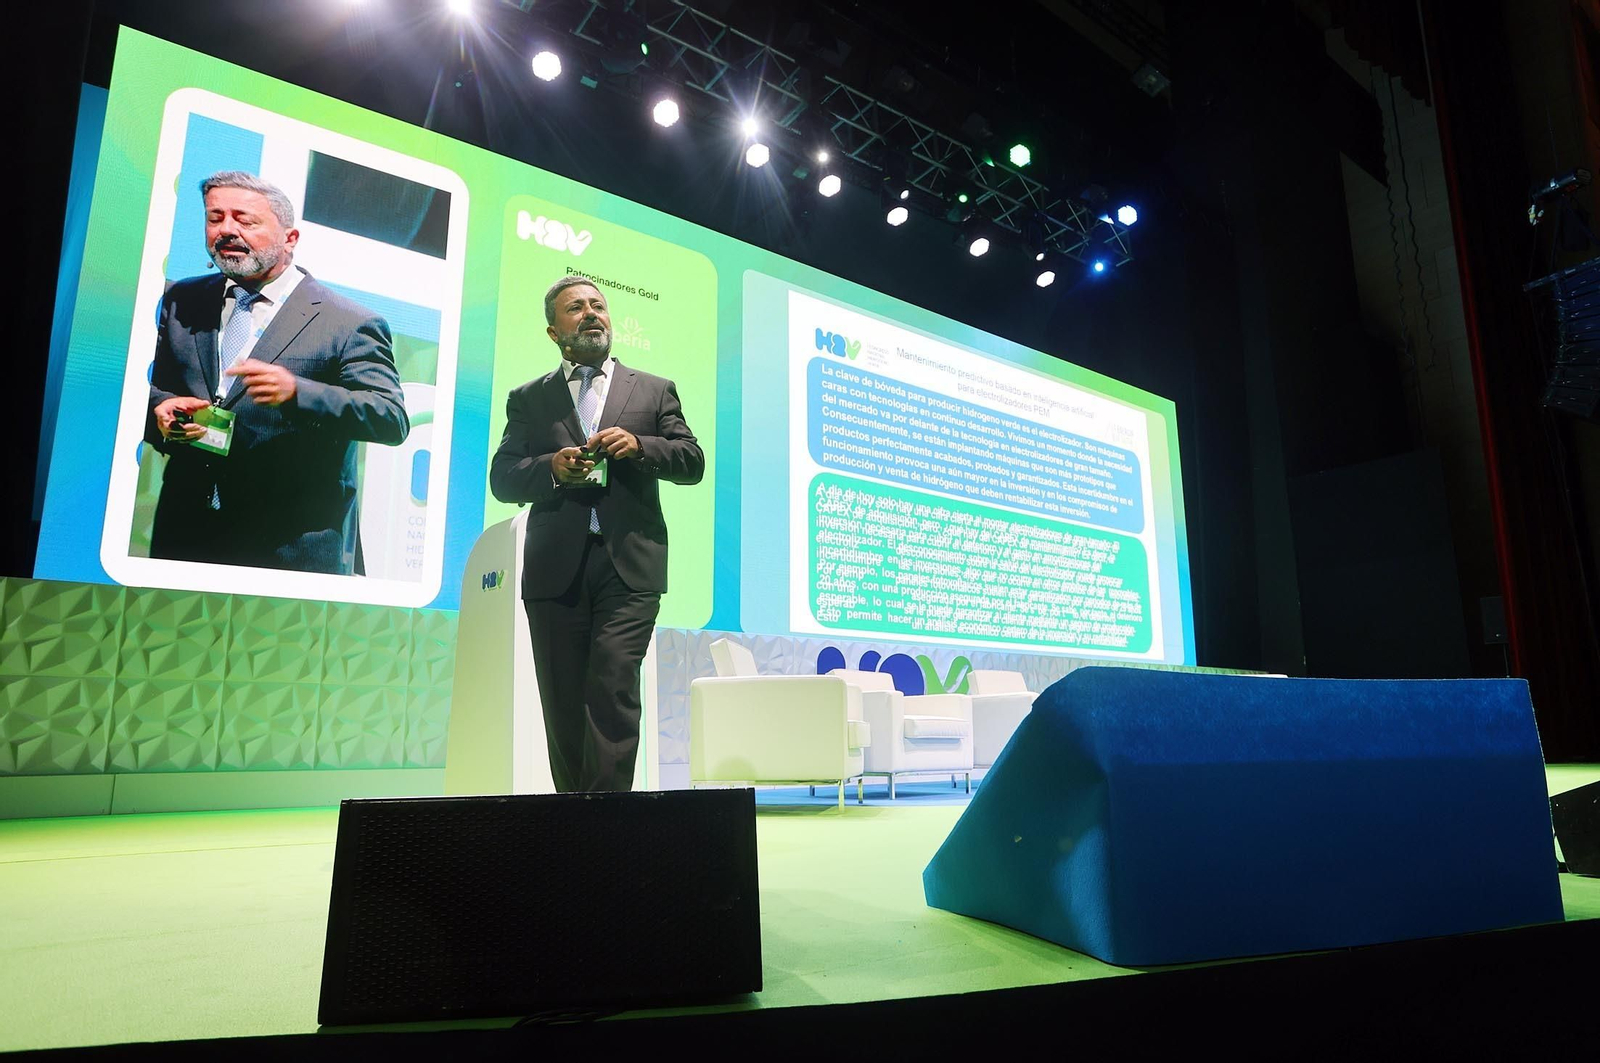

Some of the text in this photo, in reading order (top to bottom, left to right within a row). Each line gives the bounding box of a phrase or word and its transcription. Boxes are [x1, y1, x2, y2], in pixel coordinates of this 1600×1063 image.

[639, 288, 659, 301] Gold
[815, 328, 861, 360] H2V
[821, 363, 834, 376] La
[835, 368, 860, 384] clave
[861, 375, 873, 388] de
[874, 378, 906, 397] bóveda
[908, 391, 926, 403] para
[928, 397, 961, 413] producir
[1001, 418, 1021, 431] verde
[1022, 424, 1031, 433] es
[1031, 426, 1038, 436] el
[1039, 428, 1084, 449] electrolizador.
[821, 379, 848, 394] caras
[850, 387, 867, 399] con
[920, 407, 931, 417] en
[932, 411, 967, 427] continuo
[967, 419, 1006, 439] desarrollo.
[1007, 430, 1036, 447] Vivimos
[1036, 440, 1046, 449] un
[1046, 443, 1077, 458] momento
[822, 392, 837, 405] del
[839, 398, 879, 416] mercado
[880, 409, 891, 419] va
[893, 413, 907, 424] por
[909, 416, 939, 432] delante
[940, 424, 951, 436] de
[952, 427, 960, 438] la
[1000, 442, 1010, 451] en
[1011, 444, 1064, 466] electrolizadores
[822, 404, 911, 439] Consecuentemente,
[912, 431, 923, 441] se
[924, 434, 946, 447] están
[948, 438, 995, 459] implantando
[1031, 462, 1044, 472] que
[1044, 466, 1058, 475] son
[822, 423, 870, 442] productos
[872, 435, 933, 457] perfectamente
[934, 451, 974, 469] acabados,
[975, 461, 1010, 476] probados
[1011, 470, 1016, 480] y
[1017, 471, 1062, 489] garantizados.
[822, 435, 894, 461] funcionamiento
[895, 454, 930, 470] provoca
[931, 463, 946, 474] una
[948, 466, 963, 478] aún
[964, 471, 988, 484] mayor
[989, 477, 999, 486] en
[1000, 478, 1007, 488] la
[1008, 479, 1041, 496] inversión
[1041, 489, 1046, 499] y
[1047, 491, 1056, 499] en
[1056, 491, 1067, 502] los
[823, 452, 876, 471] producción
[877, 464, 884, 475] y
[885, 466, 909, 478] venta
[911, 470, 921, 481] de
[923, 472, 964, 491] hidrógeno
[965, 484, 980, 494] que
[981, 486, 1004, 500] deben
[1005, 493, 1044, 508] rentabilizar
[1044, 502, 1059, 512] esta
[408, 516, 427, 526] CO
[887, 539, 896, 549] El
[888, 555, 898, 563] en
[882, 567, 896, 578] los
[862, 582, 879, 591] con
[882, 584, 898, 593] una
[873, 596, 882, 606] lo
[886, 598, 904, 609] cual
[847, 608, 883, 623] permite
[888, 612, 912, 624] hacer
